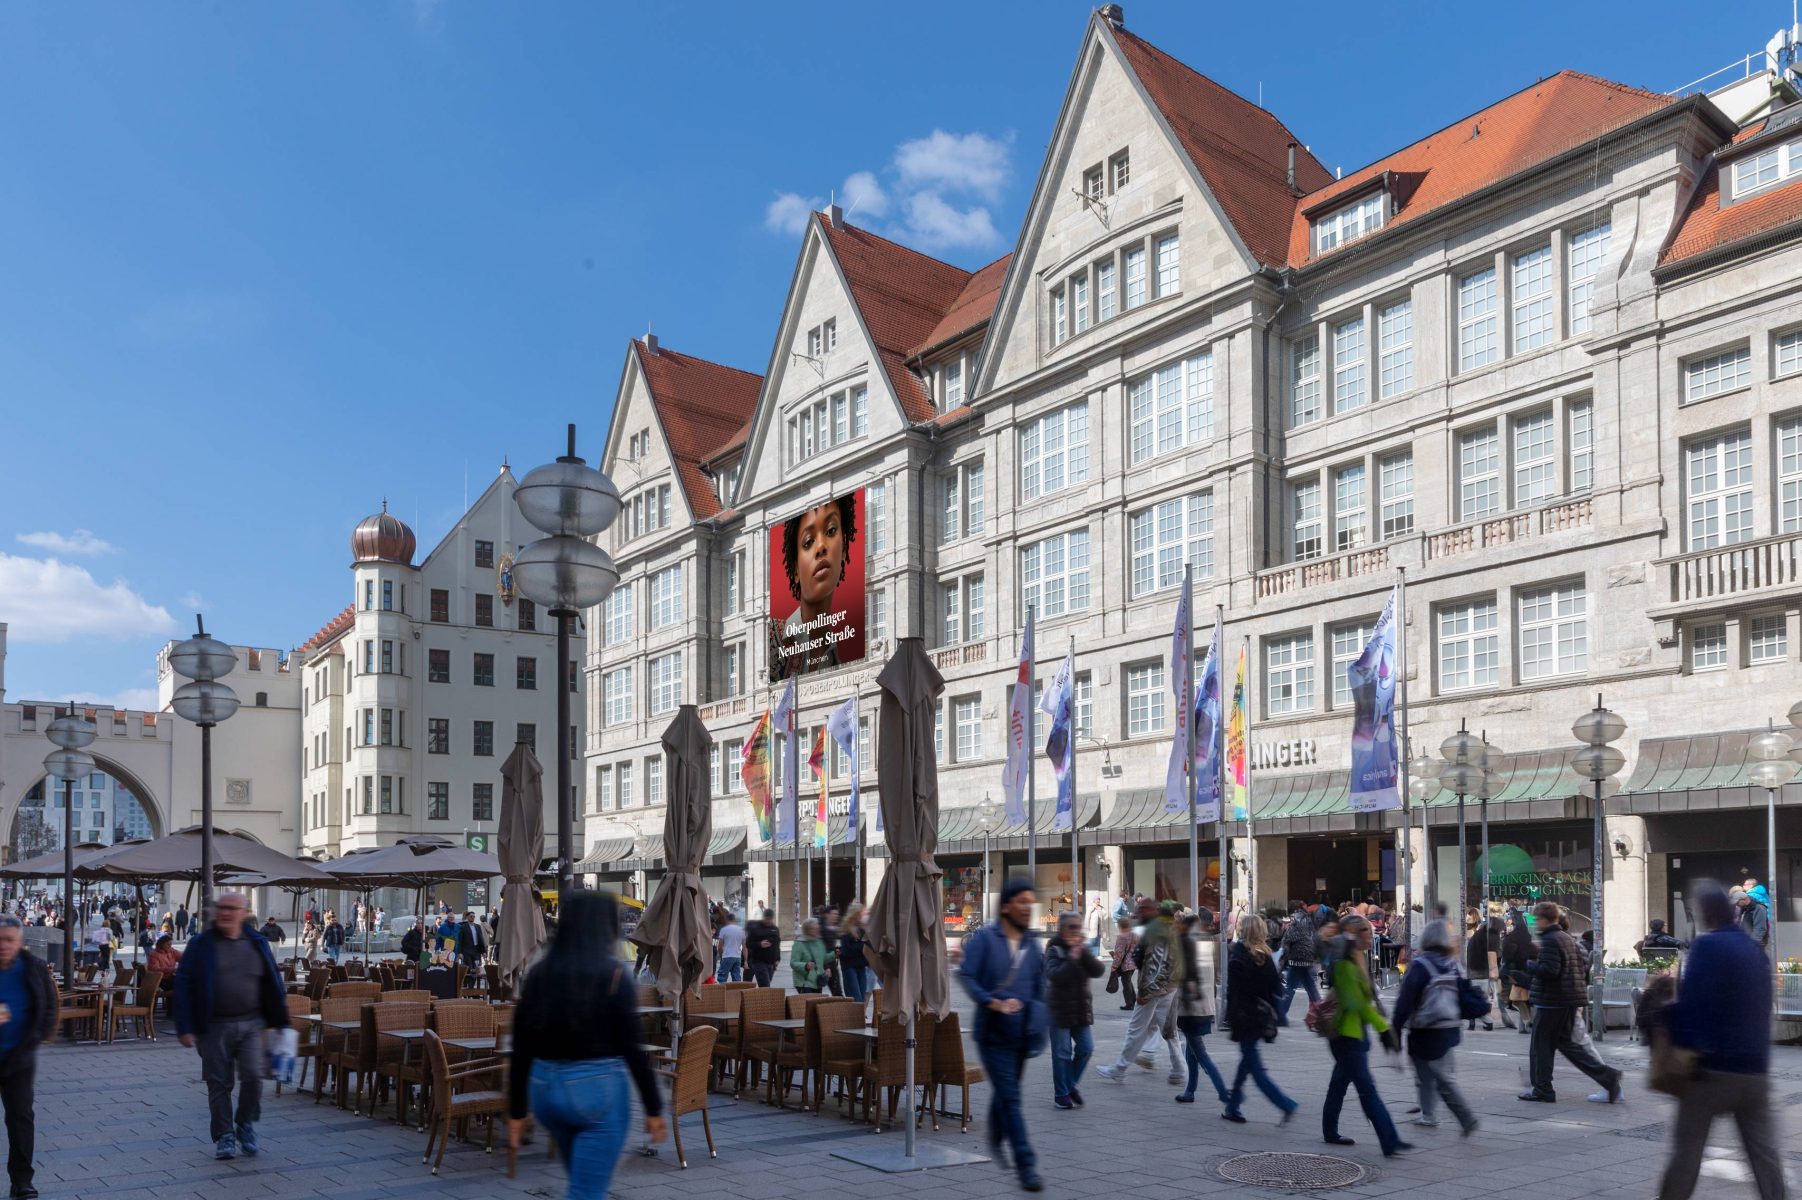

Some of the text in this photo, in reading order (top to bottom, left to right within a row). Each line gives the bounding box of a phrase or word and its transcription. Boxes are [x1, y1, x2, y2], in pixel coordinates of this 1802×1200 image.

[786, 609, 847, 637] Oberpollinger
[778, 625, 856, 659] Neuhauser Straße
[806, 654, 829, 666] München
[471, 836, 483, 852] S
[1489, 871, 1591, 884] BRINGING BACK
[1490, 885, 1517, 896] THE
